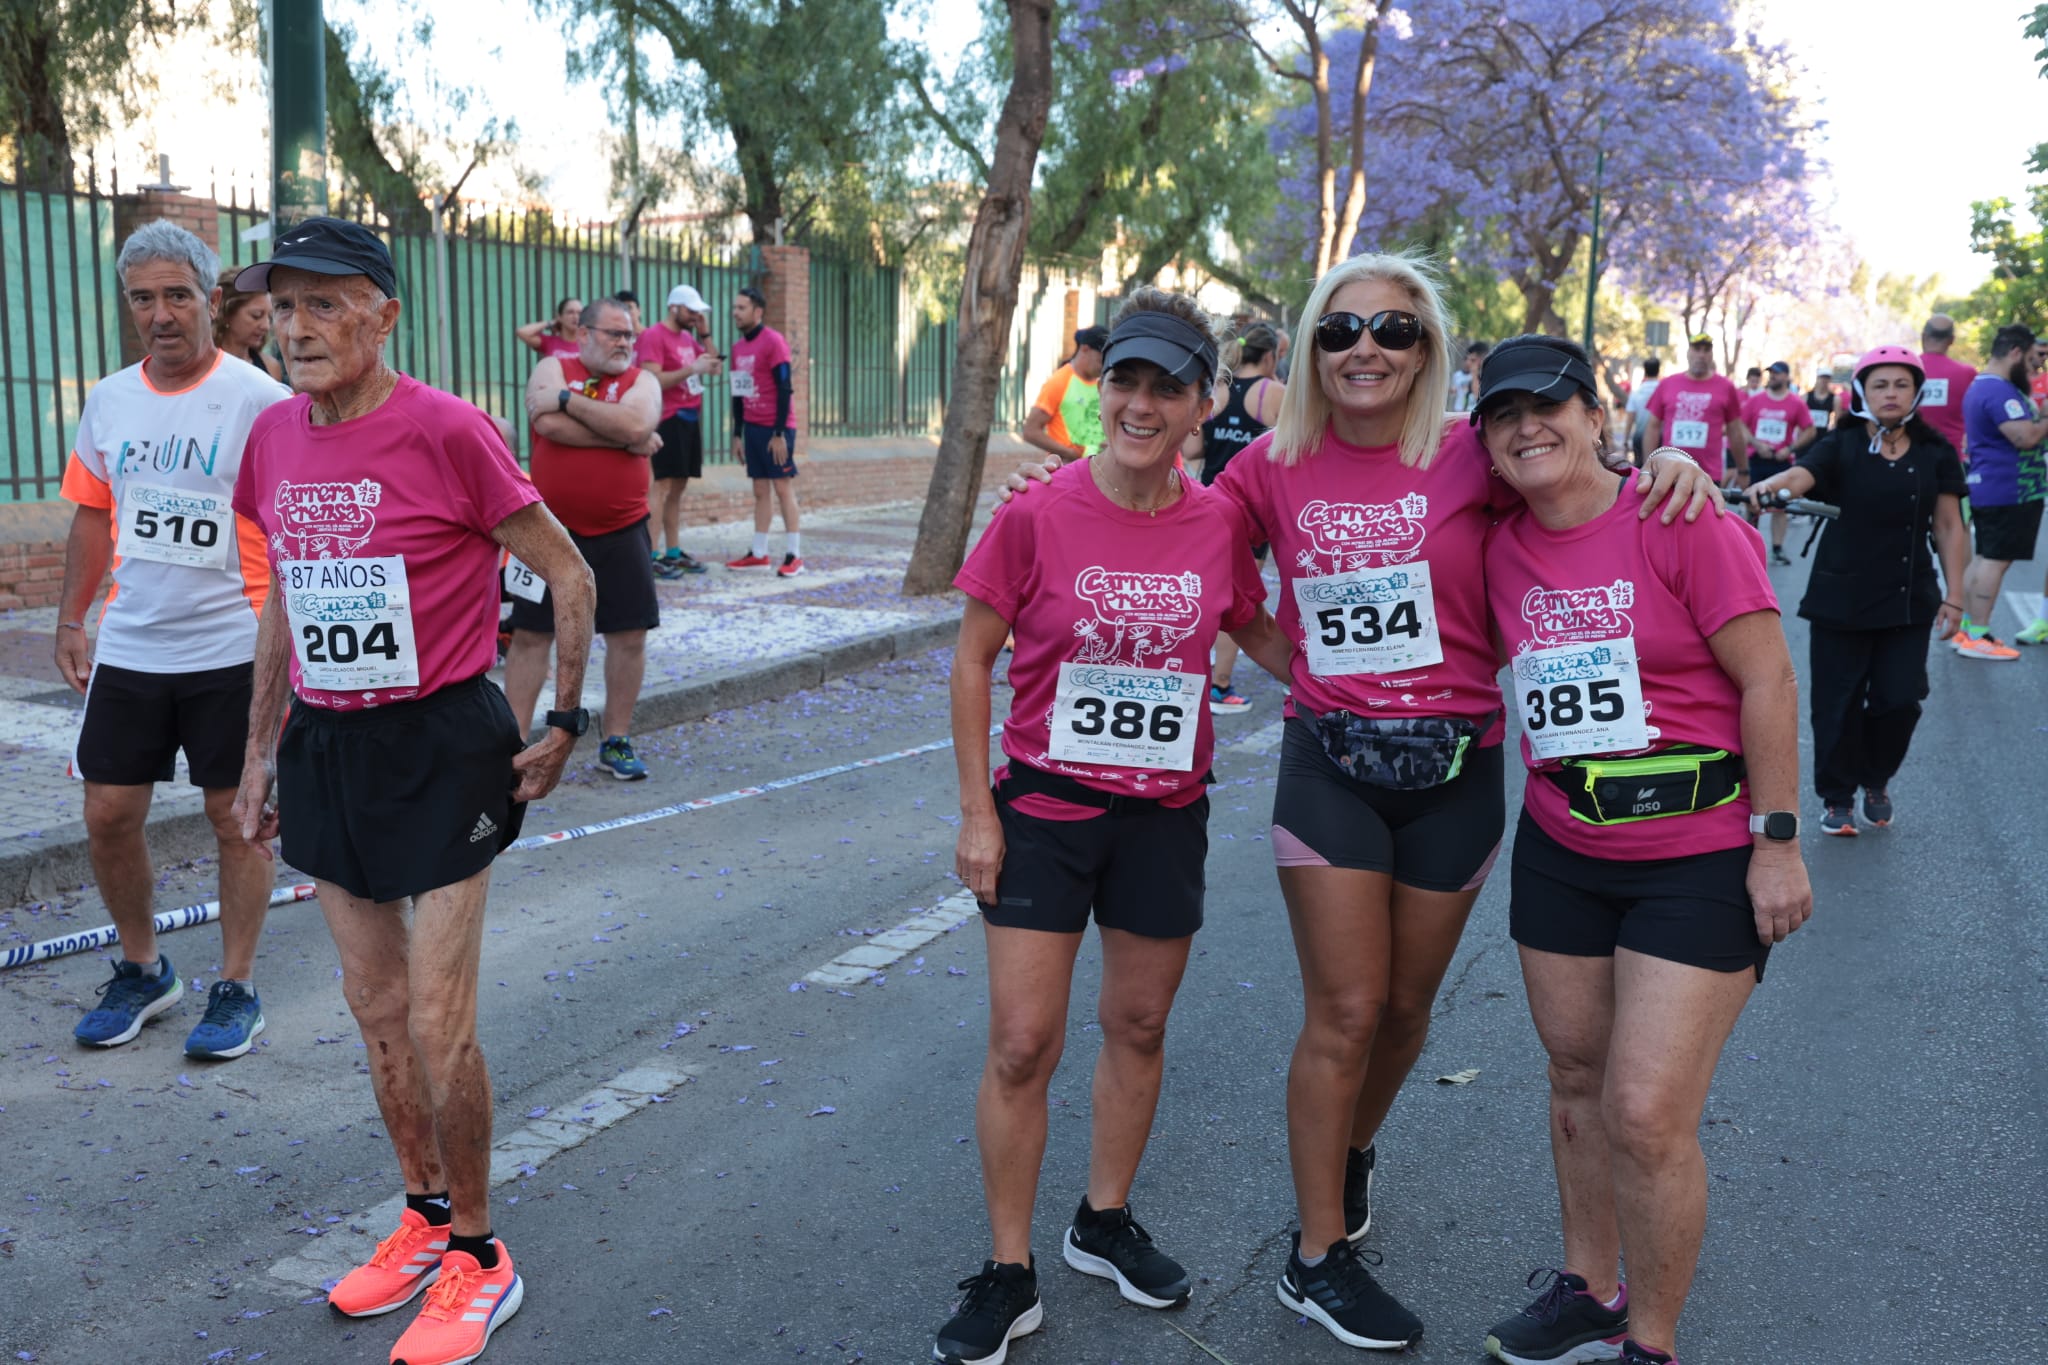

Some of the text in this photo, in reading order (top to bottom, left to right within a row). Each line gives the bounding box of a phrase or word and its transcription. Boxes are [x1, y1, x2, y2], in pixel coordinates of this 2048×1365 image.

[116, 427, 222, 479] RUN
[277, 483, 356, 506] Carrera
[1304, 502, 1403, 525] Carrera
[134, 509, 218, 547] 510
[1319, 517, 1410, 541] Prensa
[291, 560, 386, 589] 87 AÑOS
[513, 565, 534, 587] 75
[1083, 572, 1181, 594] Carrera
[304, 594, 369, 611] Carrera
[1102, 593, 1188, 610] Prensa
[1526, 589, 1610, 615] Carrera
[1317, 600, 1422, 646] 534
[1539, 607, 1617, 631] Prensa
[302, 622, 400, 663] 204
[1088, 669, 1165, 689] Carrera
[1526, 679, 1624, 731] 385
[1071, 697, 1183, 742] 386
[470, 824, 497, 842] adidas
